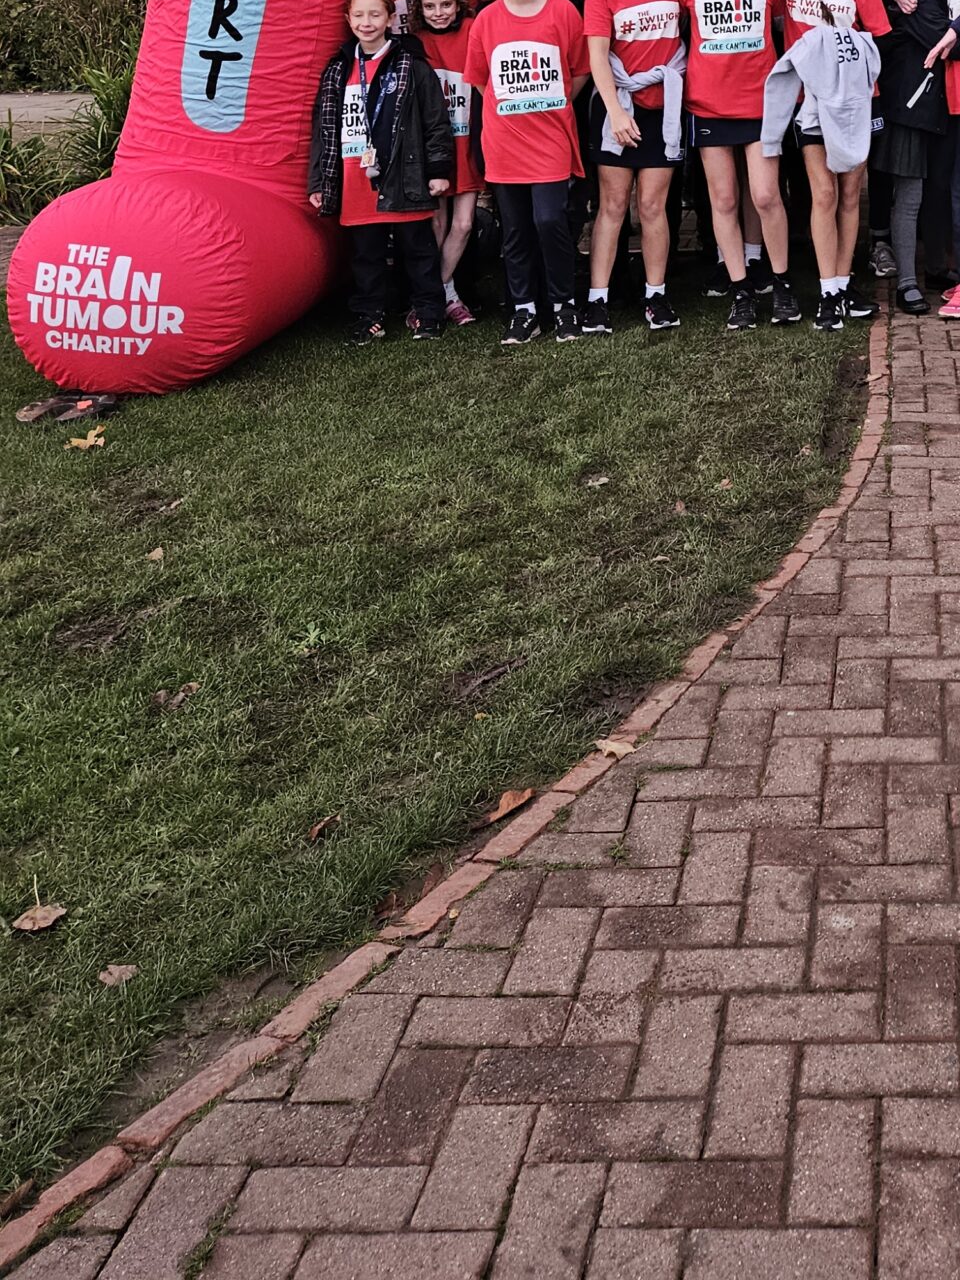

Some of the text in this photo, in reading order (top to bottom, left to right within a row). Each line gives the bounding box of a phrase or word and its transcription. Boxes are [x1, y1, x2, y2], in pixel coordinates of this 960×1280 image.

[638, 12, 681, 26] TWILIGH
[702, 11, 761, 26] TUMOUR
[799, 6, 821, 18] WAL
[712, 24, 752, 34] CHARITY
[709, 43, 724, 51] CURE
[748, 39, 762, 49] WAIT
[512, 49, 529, 58] THE
[500, 51, 551, 72] BRAIN
[498, 69, 559, 86] TUMOUR
[508, 83, 550, 94] CHARITY
[505, 103, 521, 112] CURE
[67, 243, 110, 266] THE
[34, 255, 161, 302] BRAIN
[26, 293, 185, 334] TUMOUR
[45, 330, 152, 356] CHARITY
